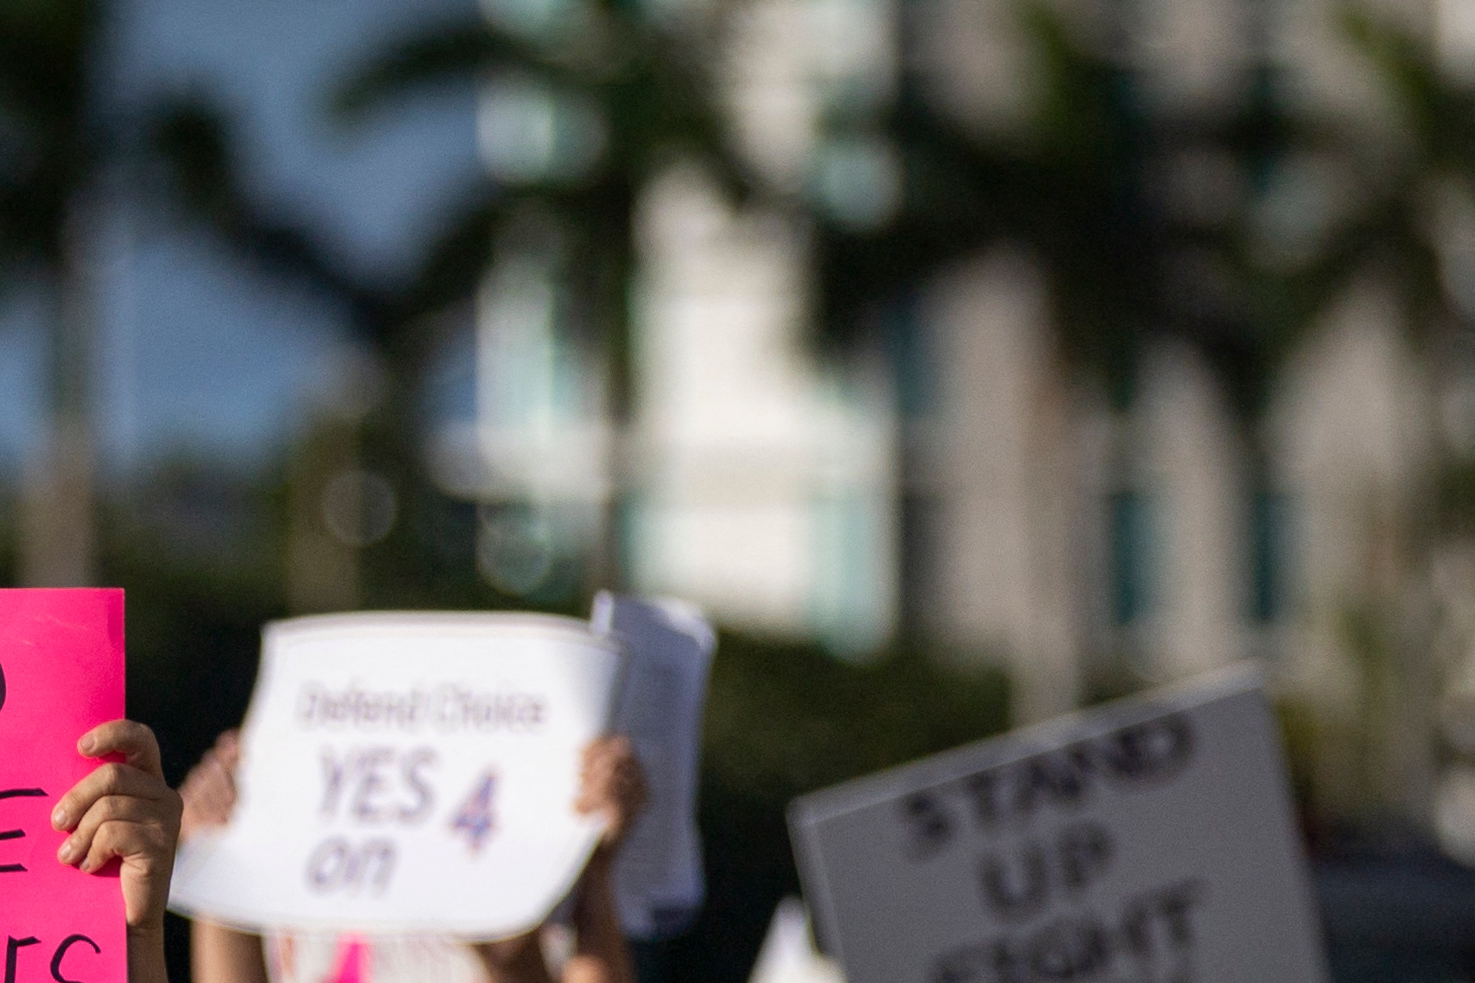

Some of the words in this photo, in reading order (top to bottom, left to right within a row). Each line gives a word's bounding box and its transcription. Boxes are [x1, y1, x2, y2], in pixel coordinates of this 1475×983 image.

[320, 745, 439, 826] YES
[447, 763, 503, 860] 4
[898, 712, 1196, 860] STAND
[304, 836, 400, 898] on
[976, 820, 1114, 925] UP
